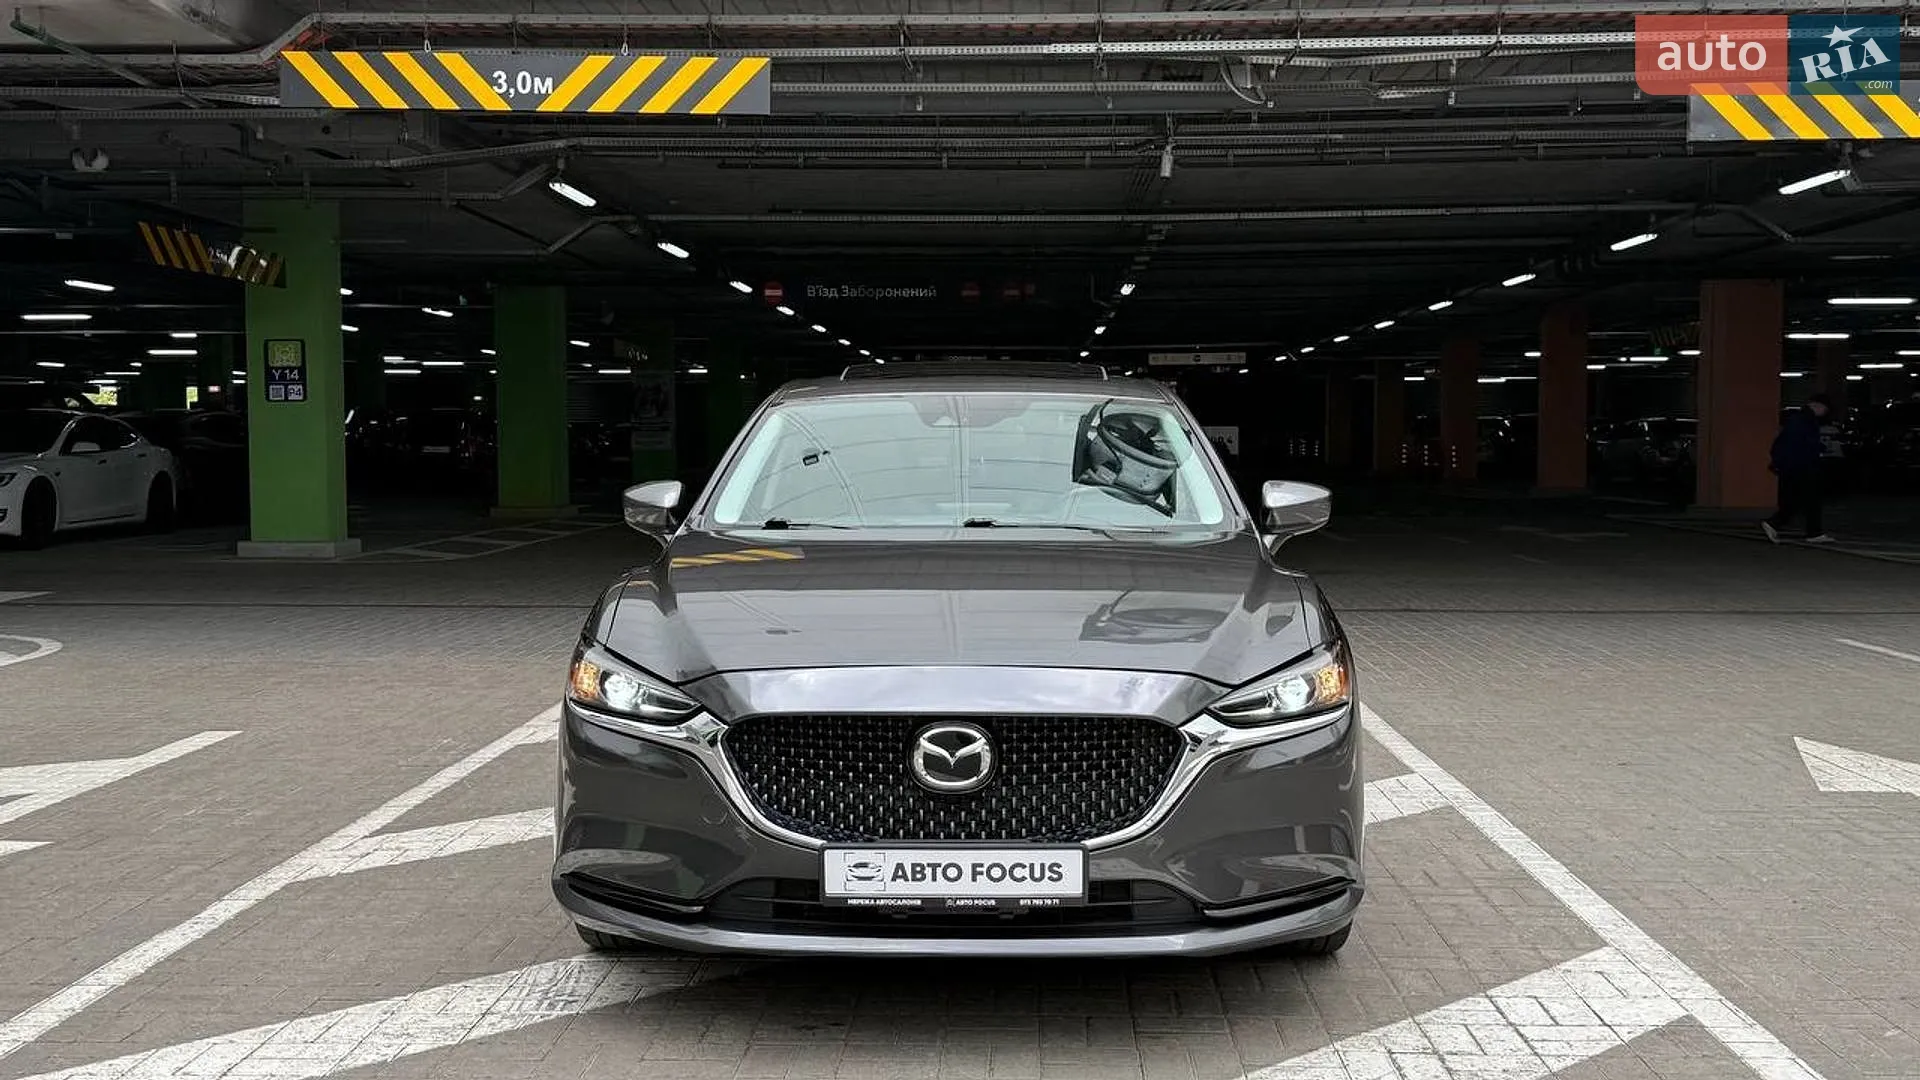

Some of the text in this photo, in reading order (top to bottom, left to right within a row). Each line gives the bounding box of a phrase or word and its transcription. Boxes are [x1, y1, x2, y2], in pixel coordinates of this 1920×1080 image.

[841, 285, 937, 299] Заборонений
[272, 369, 299, 380] Y 14
[890, 862, 1064, 883] АВТО FOCUS
